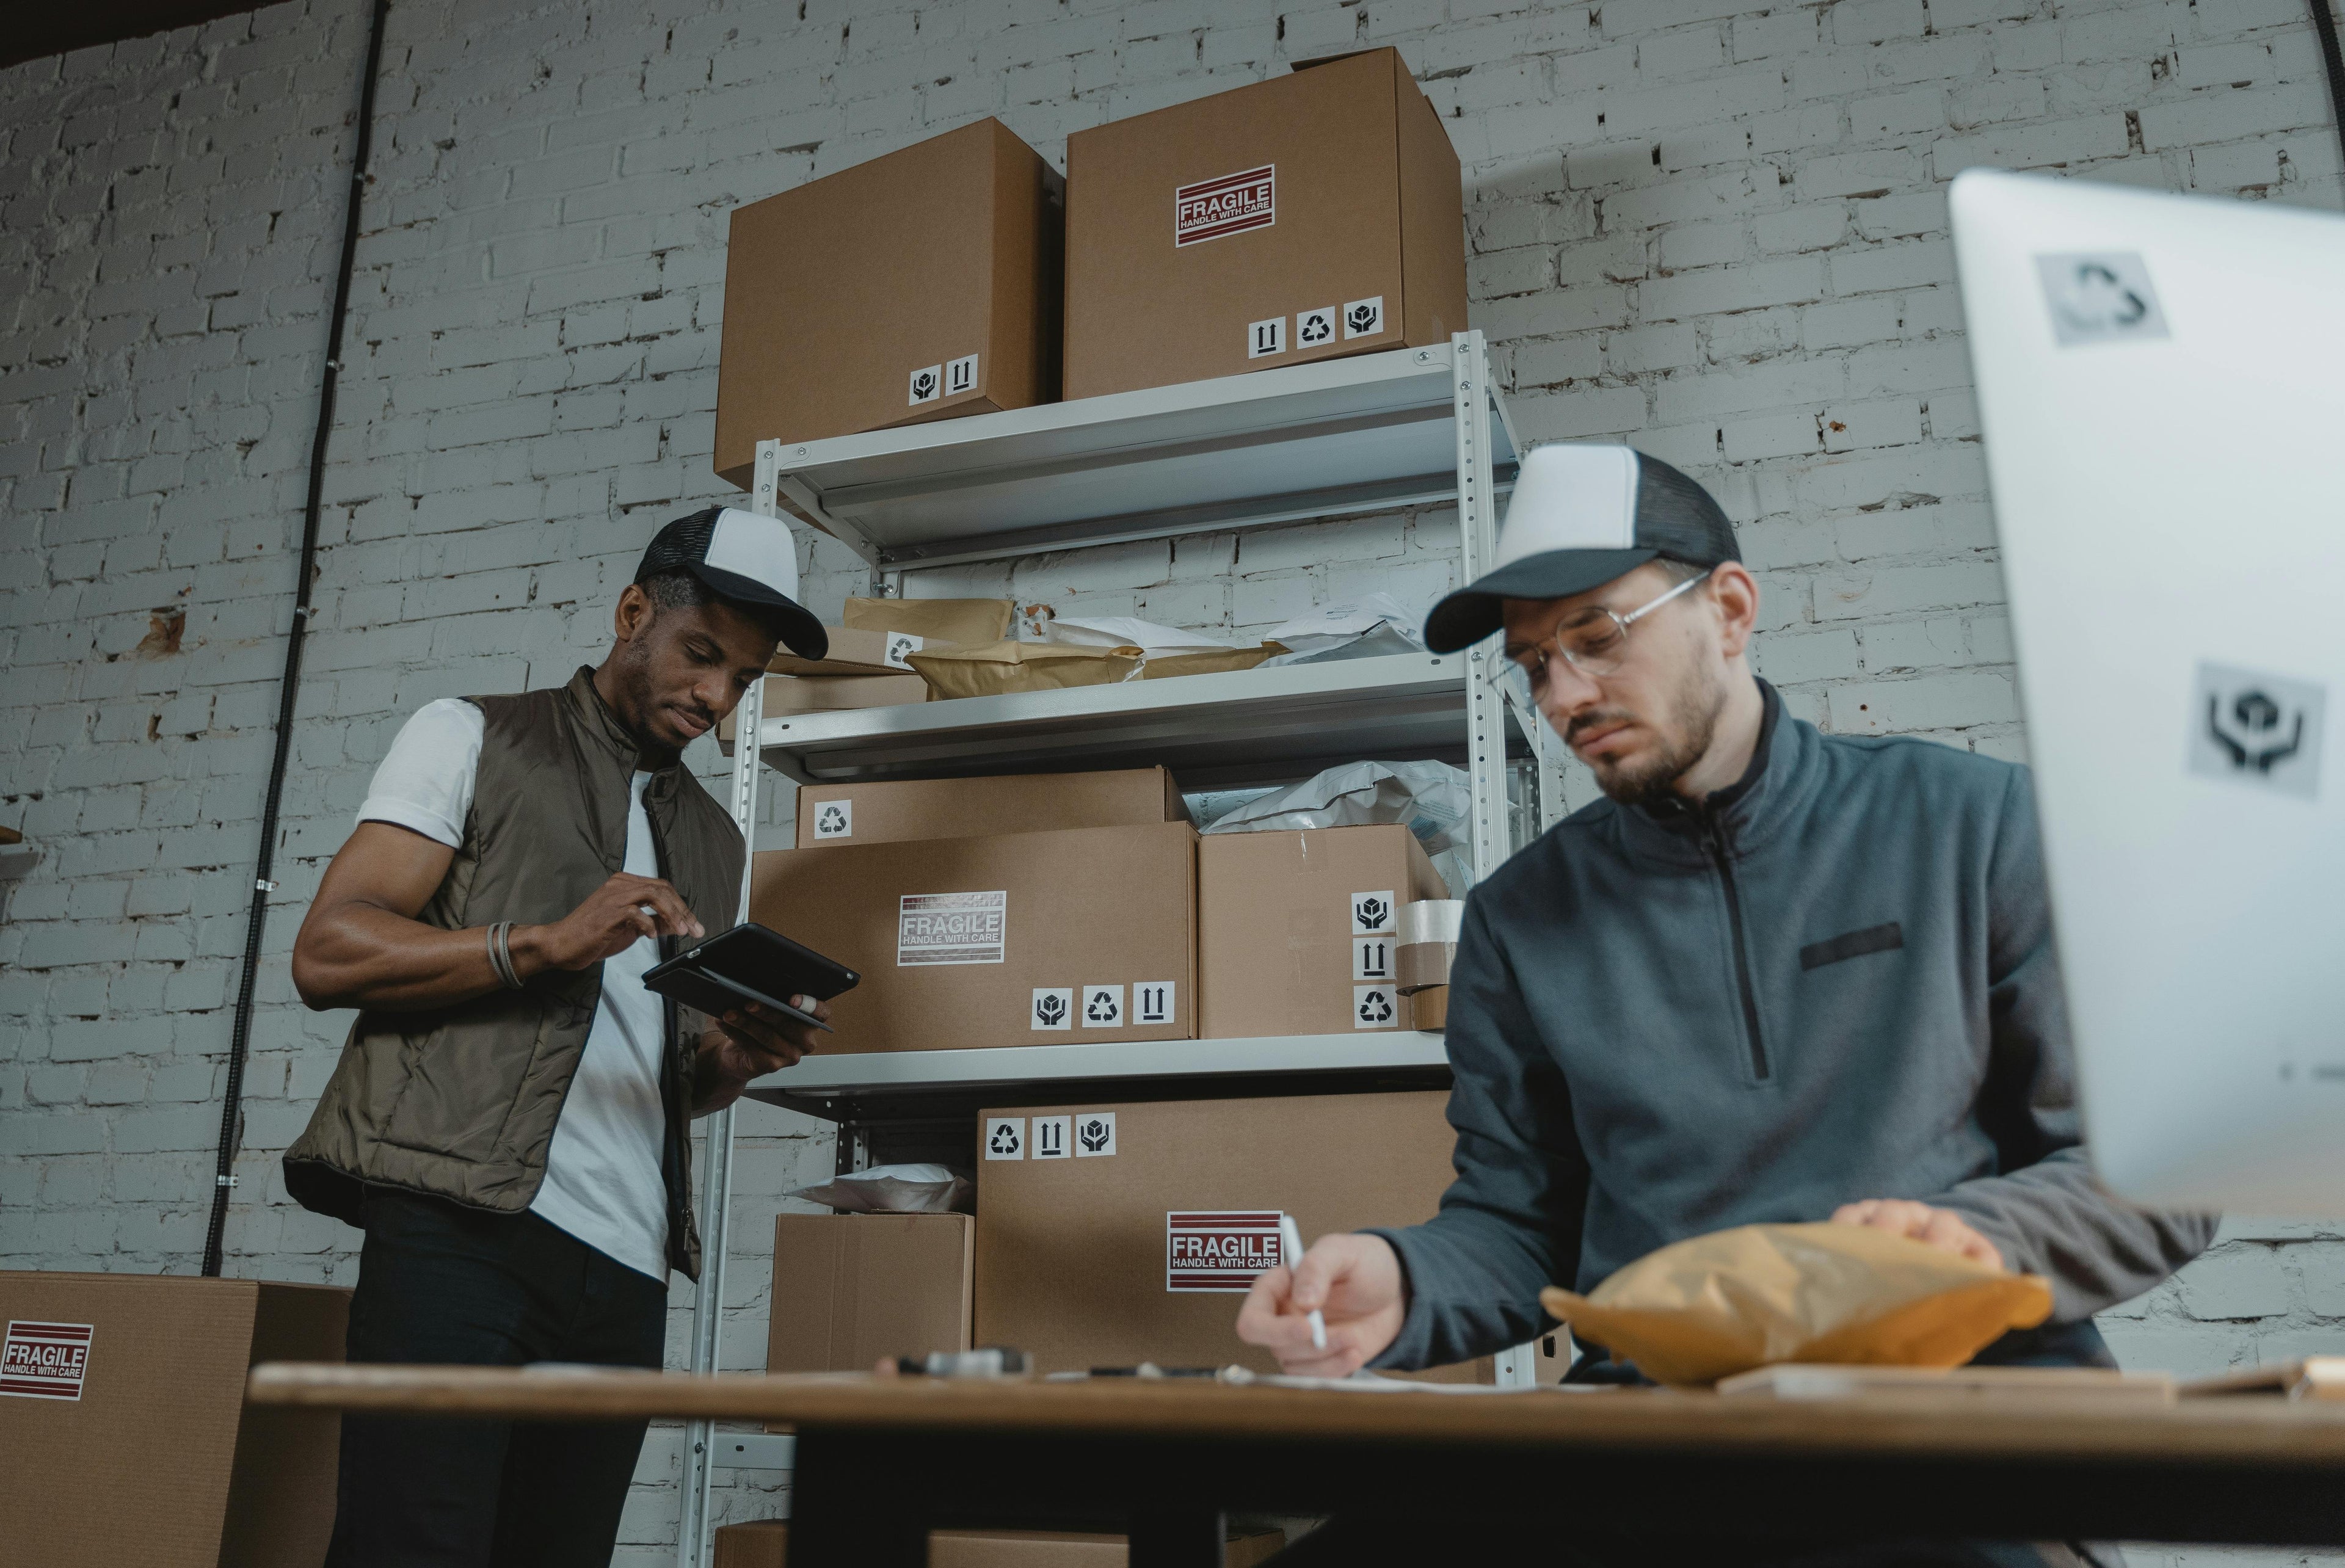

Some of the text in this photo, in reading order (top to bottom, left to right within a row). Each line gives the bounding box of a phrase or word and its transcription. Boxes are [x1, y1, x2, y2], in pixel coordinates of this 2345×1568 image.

[1180, 184, 1270, 221] FRAGILE
[1180, 201, 1270, 229] HANDLE WITH CARE
[903, 914, 999, 935] FRAGILE
[903, 935, 942, 945] HANDLE
[945, 934, 968, 943] WITH
[1172, 1236, 1278, 1257] FRAGILE
[1172, 1258, 1278, 1268] HANDLE WITH CARE
[5, 1344, 85, 1368] FRAGILE
[4, 1364, 81, 1377] HANDLE WITH CARE
